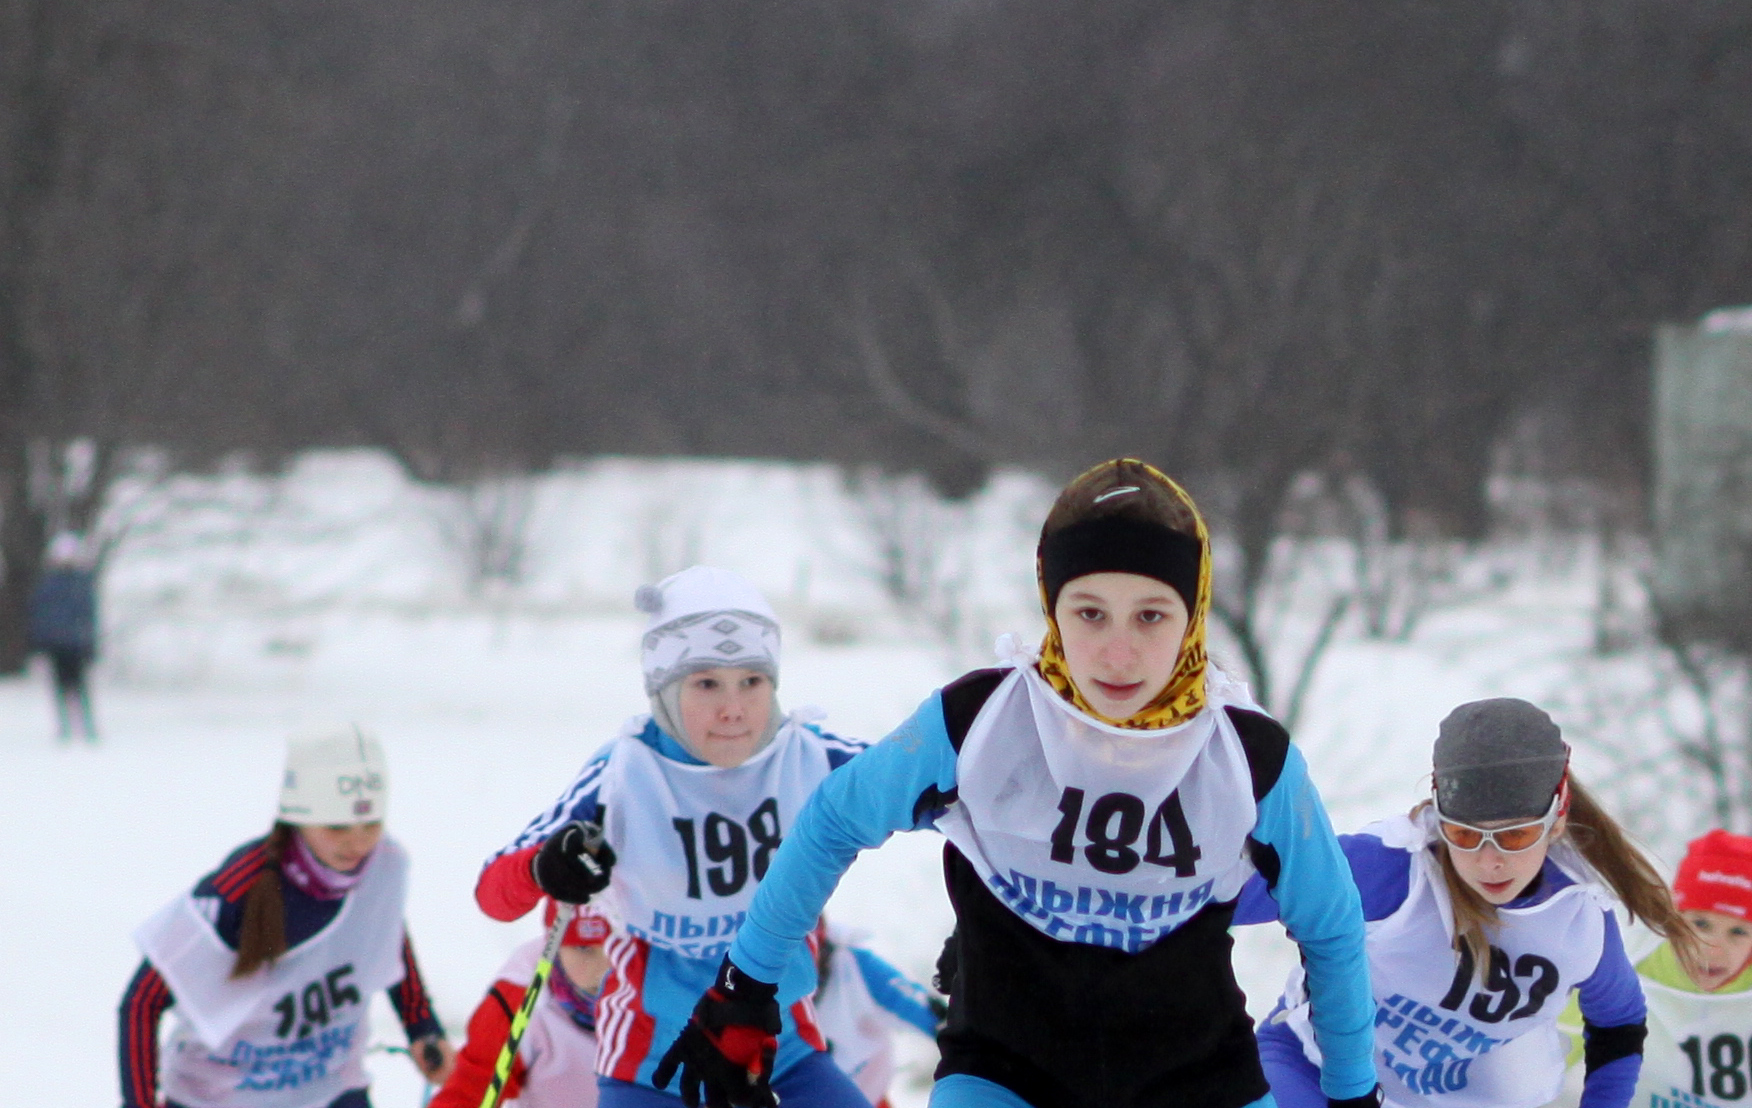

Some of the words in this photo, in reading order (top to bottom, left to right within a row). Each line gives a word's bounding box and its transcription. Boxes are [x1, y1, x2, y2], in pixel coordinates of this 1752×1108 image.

[672, 797, 784, 900] 198
[1051, 785, 1202, 878] 184
[651, 909, 748, 940] ЛЫЖ
[1008, 868, 1215, 924] ЛЫЖНЯ
[273, 963, 362, 1039] 195
